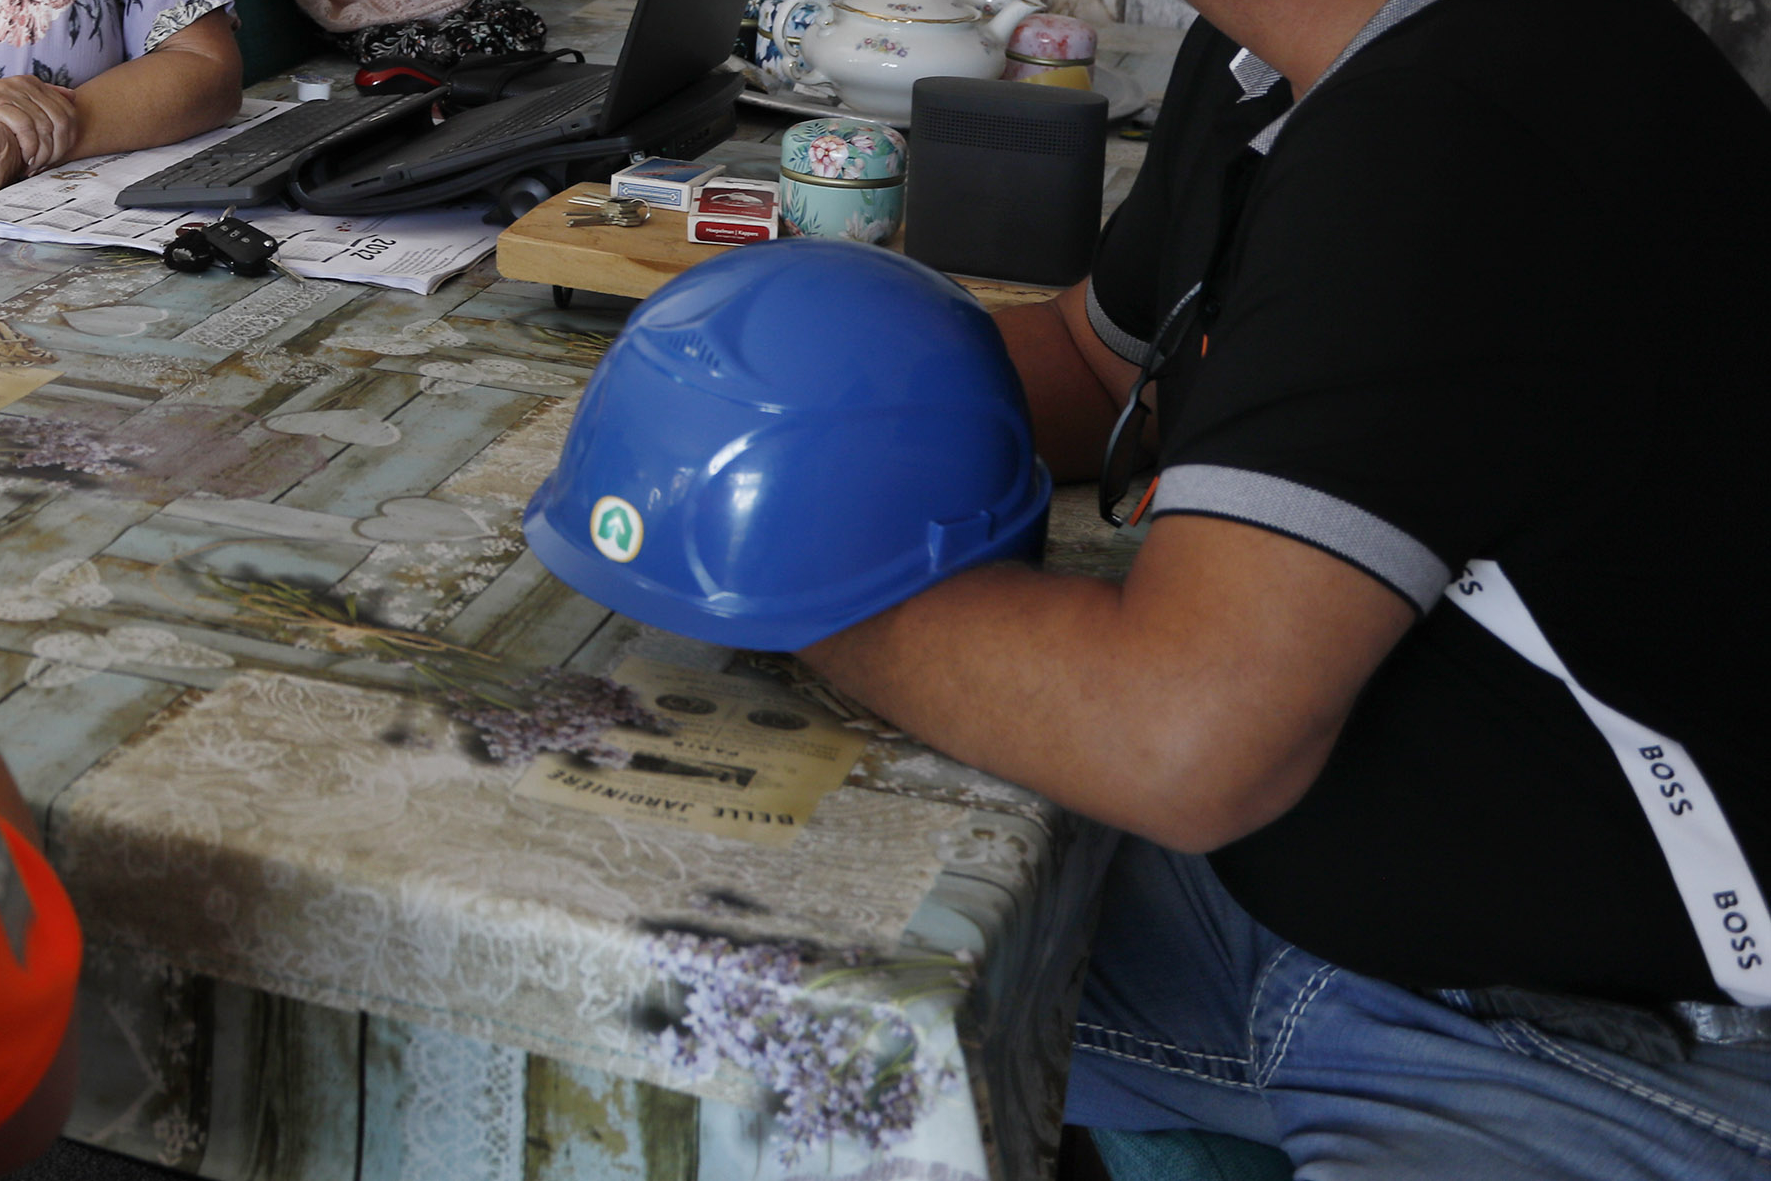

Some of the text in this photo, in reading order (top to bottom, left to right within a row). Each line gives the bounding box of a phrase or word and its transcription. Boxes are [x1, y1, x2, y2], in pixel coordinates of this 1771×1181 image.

[350, 238, 397, 261] 2022
[1638, 744, 1694, 817] BOSS
[712, 806, 796, 826] BELLE
[1712, 889, 1763, 971] BOSS
